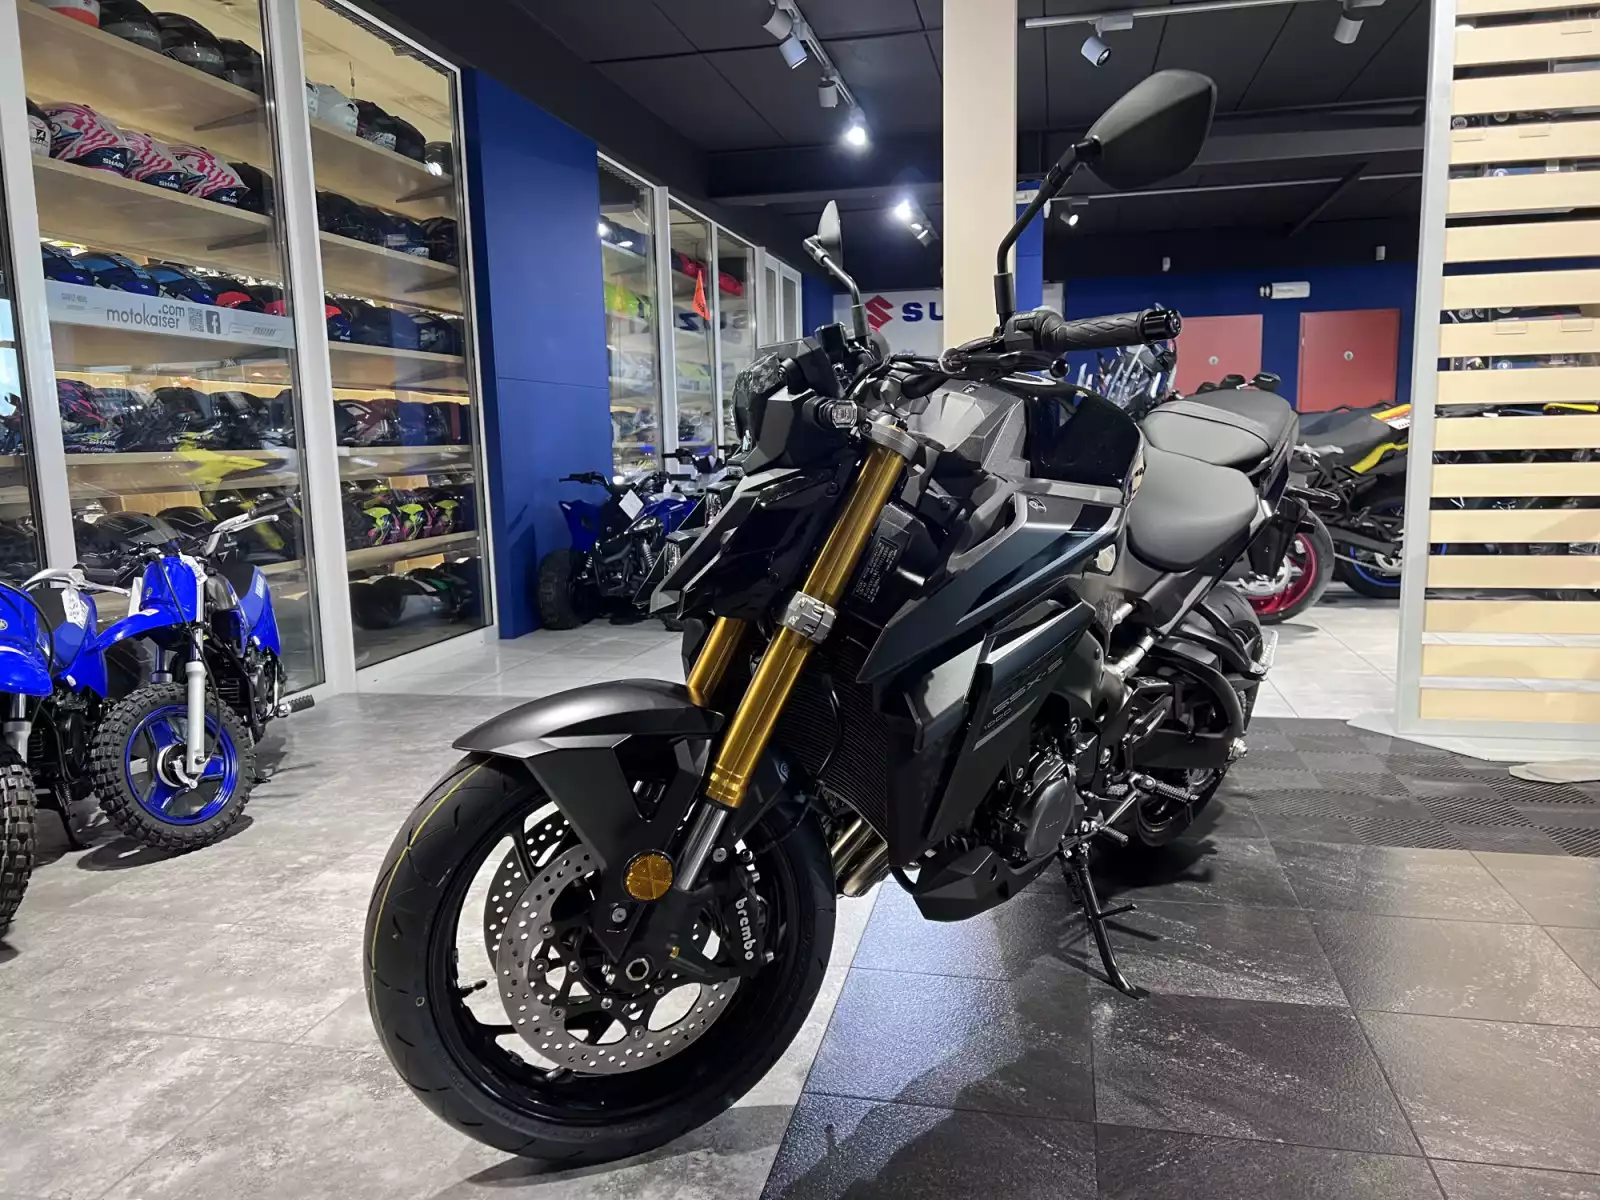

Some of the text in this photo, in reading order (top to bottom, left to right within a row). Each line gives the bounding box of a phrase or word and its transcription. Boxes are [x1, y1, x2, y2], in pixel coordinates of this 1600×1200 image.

[106, 303, 181, 330] motokaiser
[158, 303, 186, 318] .com
[735, 897, 756, 960] brembo
